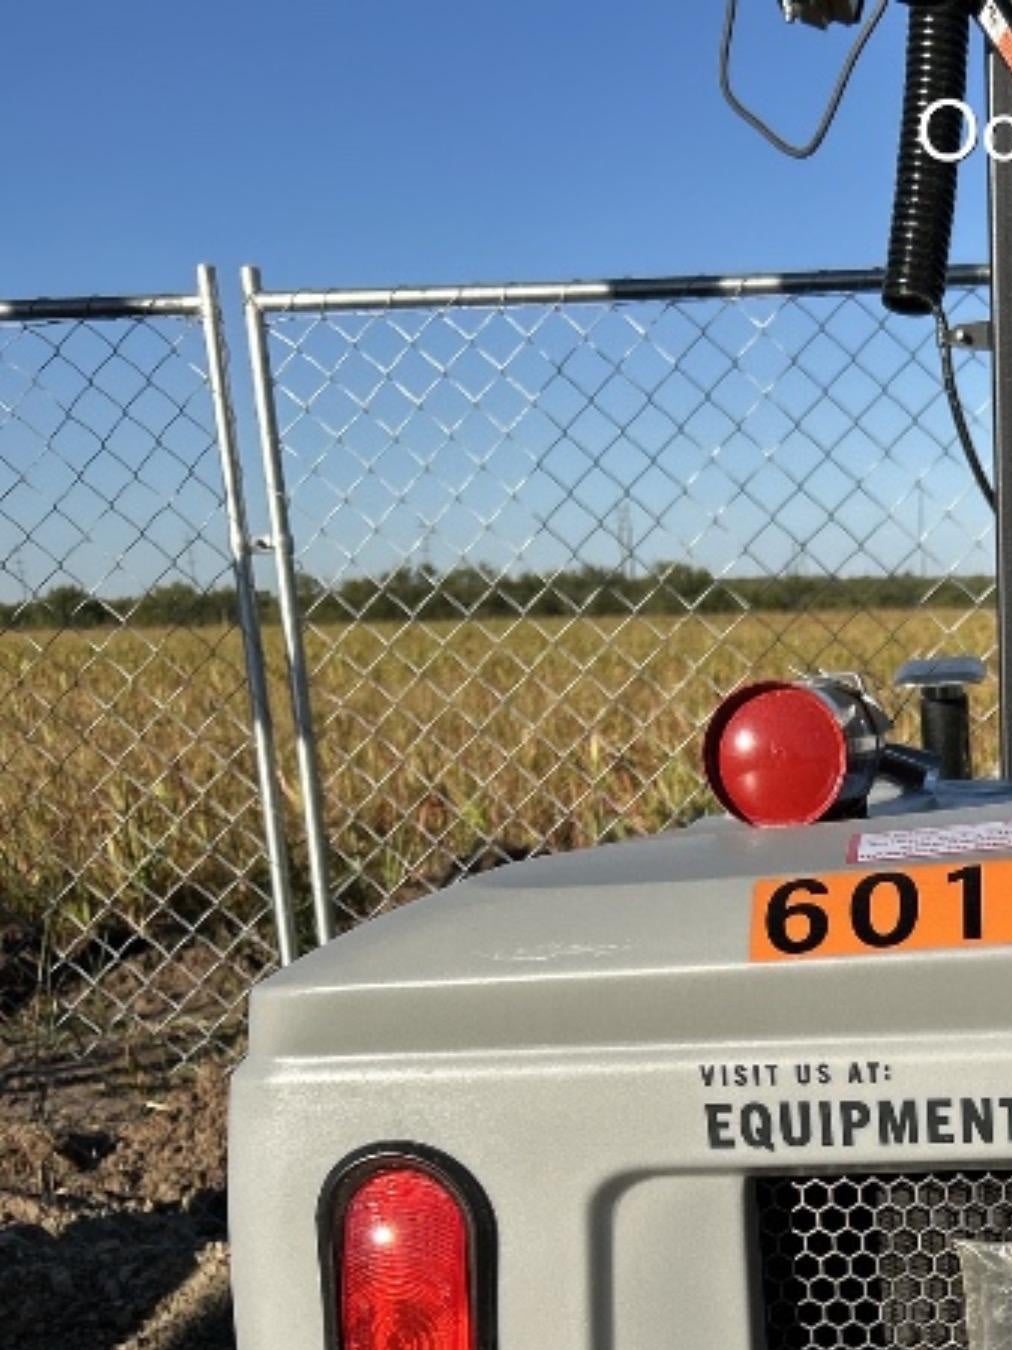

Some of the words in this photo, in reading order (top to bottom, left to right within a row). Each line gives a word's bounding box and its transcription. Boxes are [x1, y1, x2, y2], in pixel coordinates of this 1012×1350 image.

[700, 1064, 779, 1087] VISIT
[795, 1063, 832, 1085] US
[848, 1061, 892, 1084] AT:
